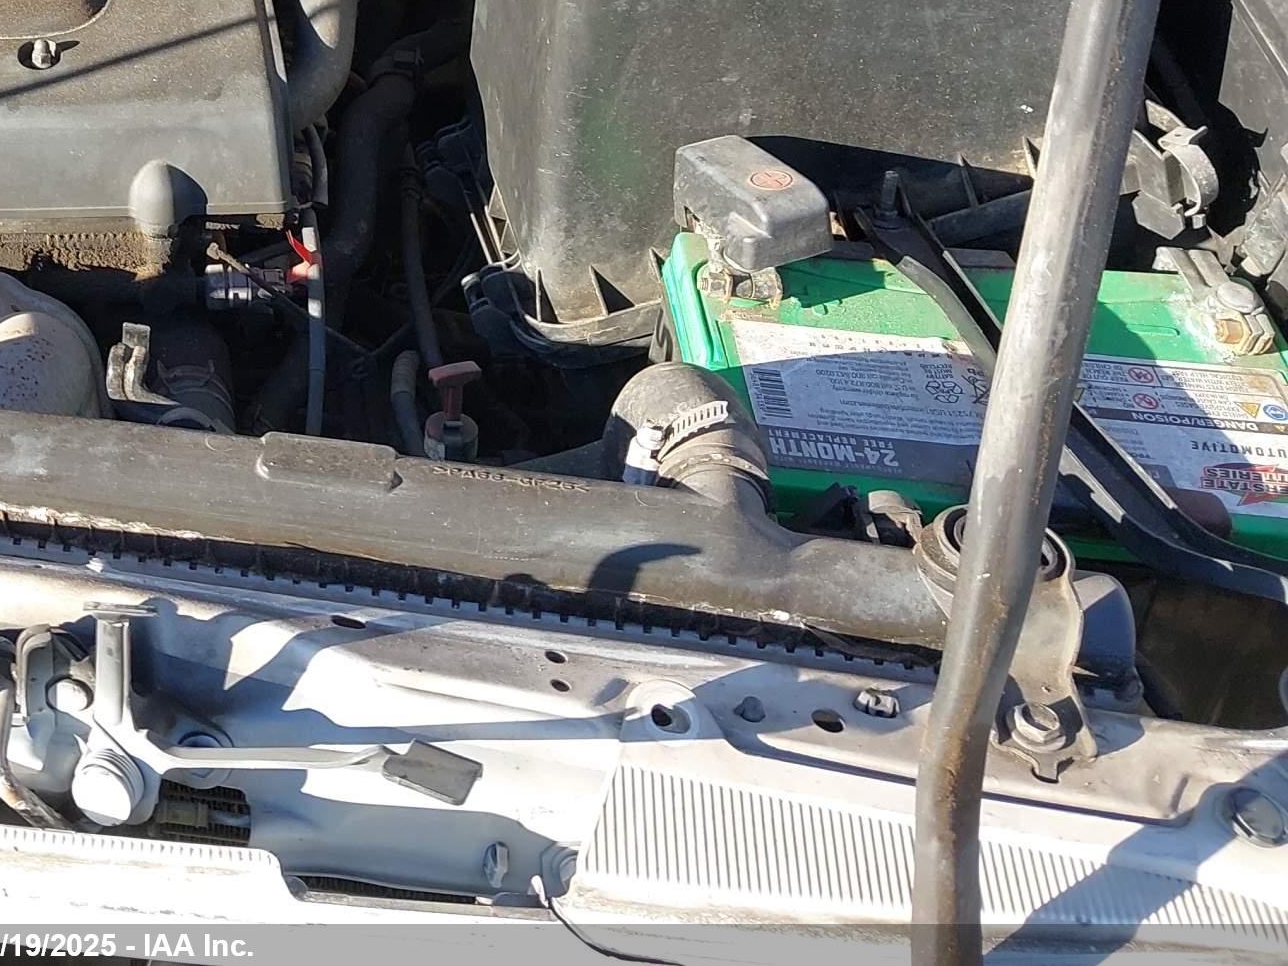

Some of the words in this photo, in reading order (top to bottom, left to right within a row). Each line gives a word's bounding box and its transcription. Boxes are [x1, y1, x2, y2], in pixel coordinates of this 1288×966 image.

[1130, 412, 1260, 432] DANGER/POISON
[769, 428, 857, 446] REPLACEMENT
[863, 439, 894, 450] FREE
[769, 436, 899, 467] 24-MONTH
[1190, 440, 1288, 459] UTOMOTIVE
